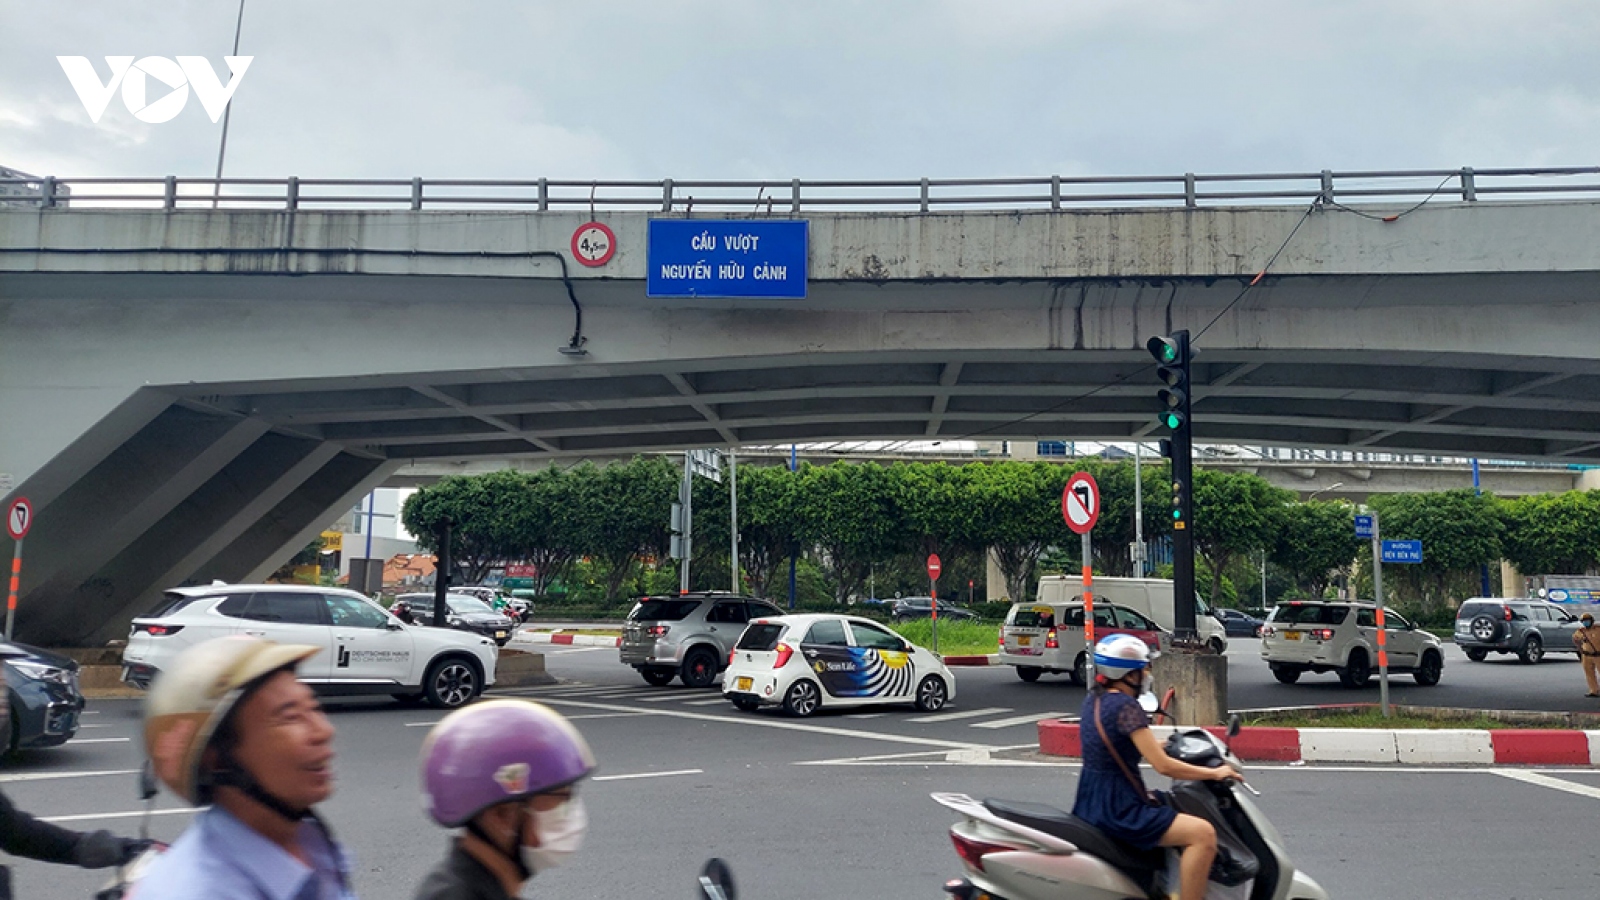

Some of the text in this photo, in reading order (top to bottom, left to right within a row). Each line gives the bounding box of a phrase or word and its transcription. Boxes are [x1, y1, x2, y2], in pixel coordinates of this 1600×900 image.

[724, 233, 759, 254] VƯỢT
[661, 259, 787, 280] NGUYỄN HỮU CẢNH
